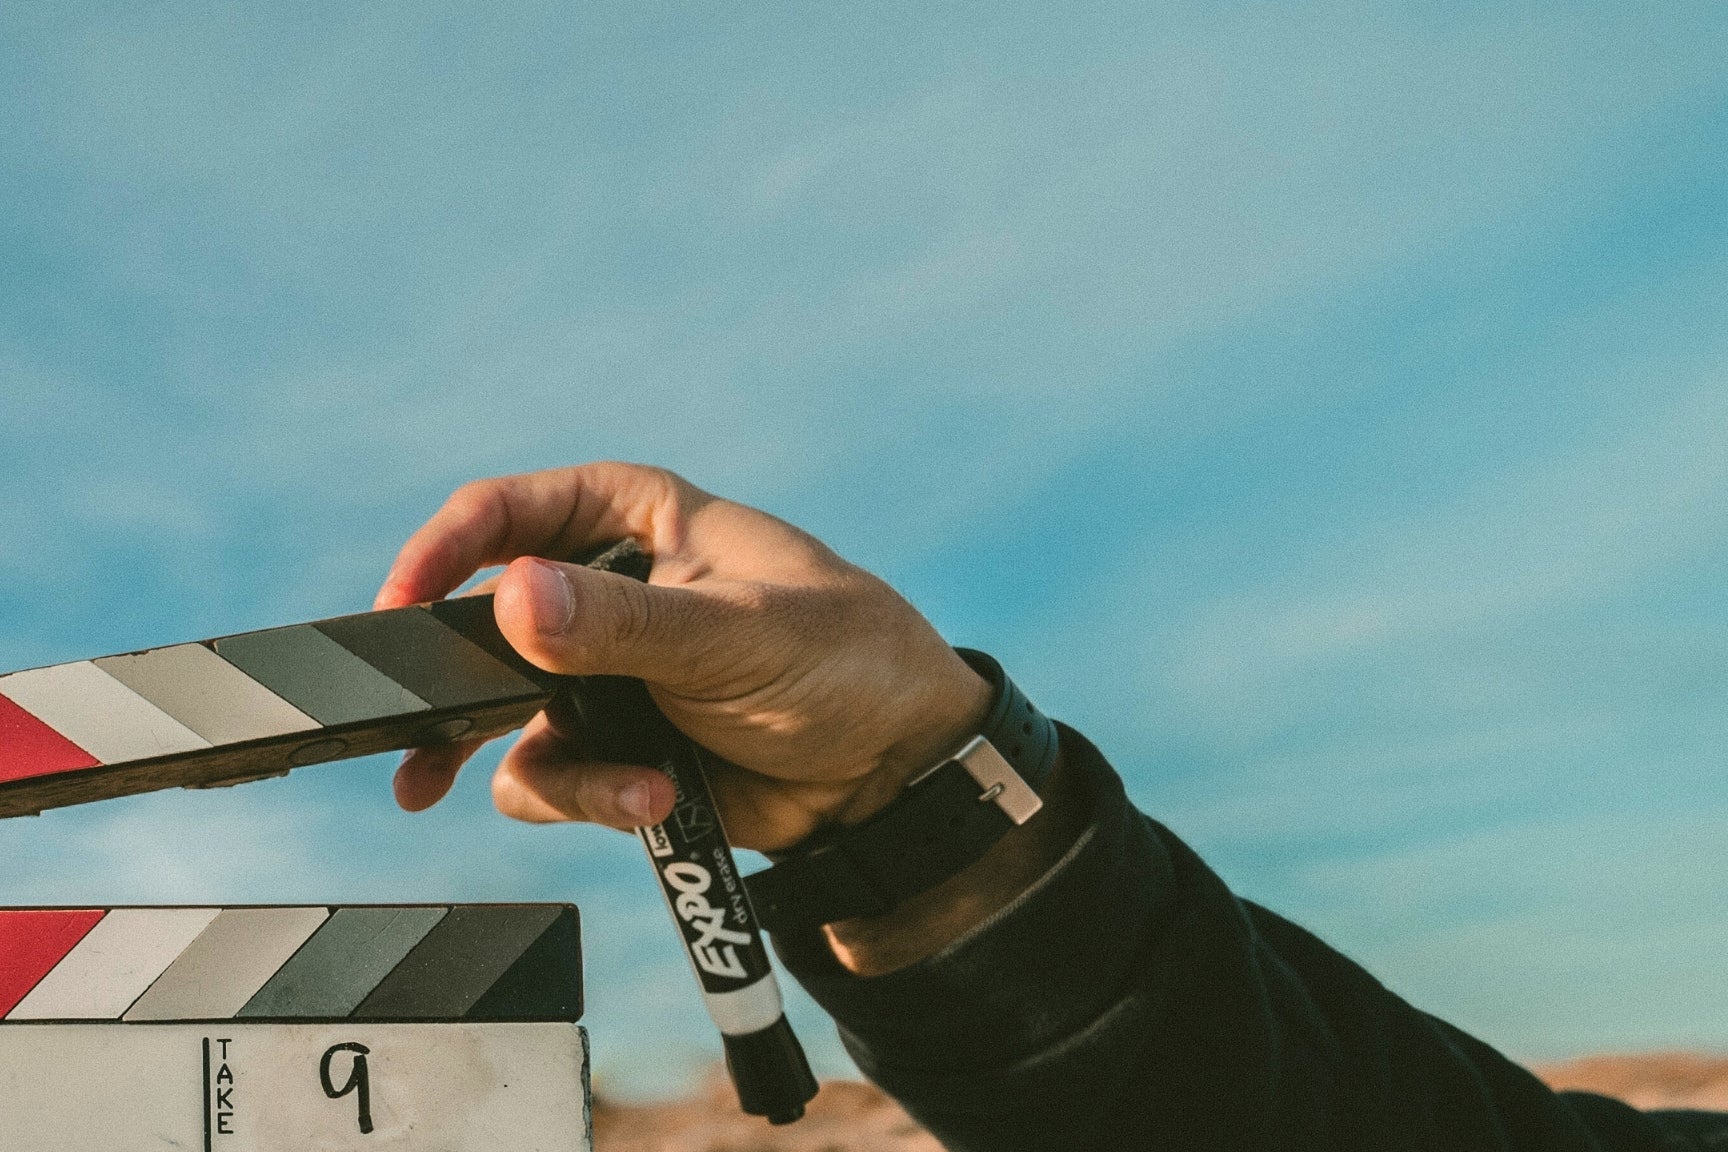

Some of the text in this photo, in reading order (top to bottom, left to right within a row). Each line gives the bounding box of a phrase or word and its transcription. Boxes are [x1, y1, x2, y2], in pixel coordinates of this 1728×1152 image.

[663, 861, 752, 979] EXPO
[712, 848, 749, 925] dry erase
[216, 1038, 235, 1135] TAKE
[319, 1041, 374, 1135] 9
